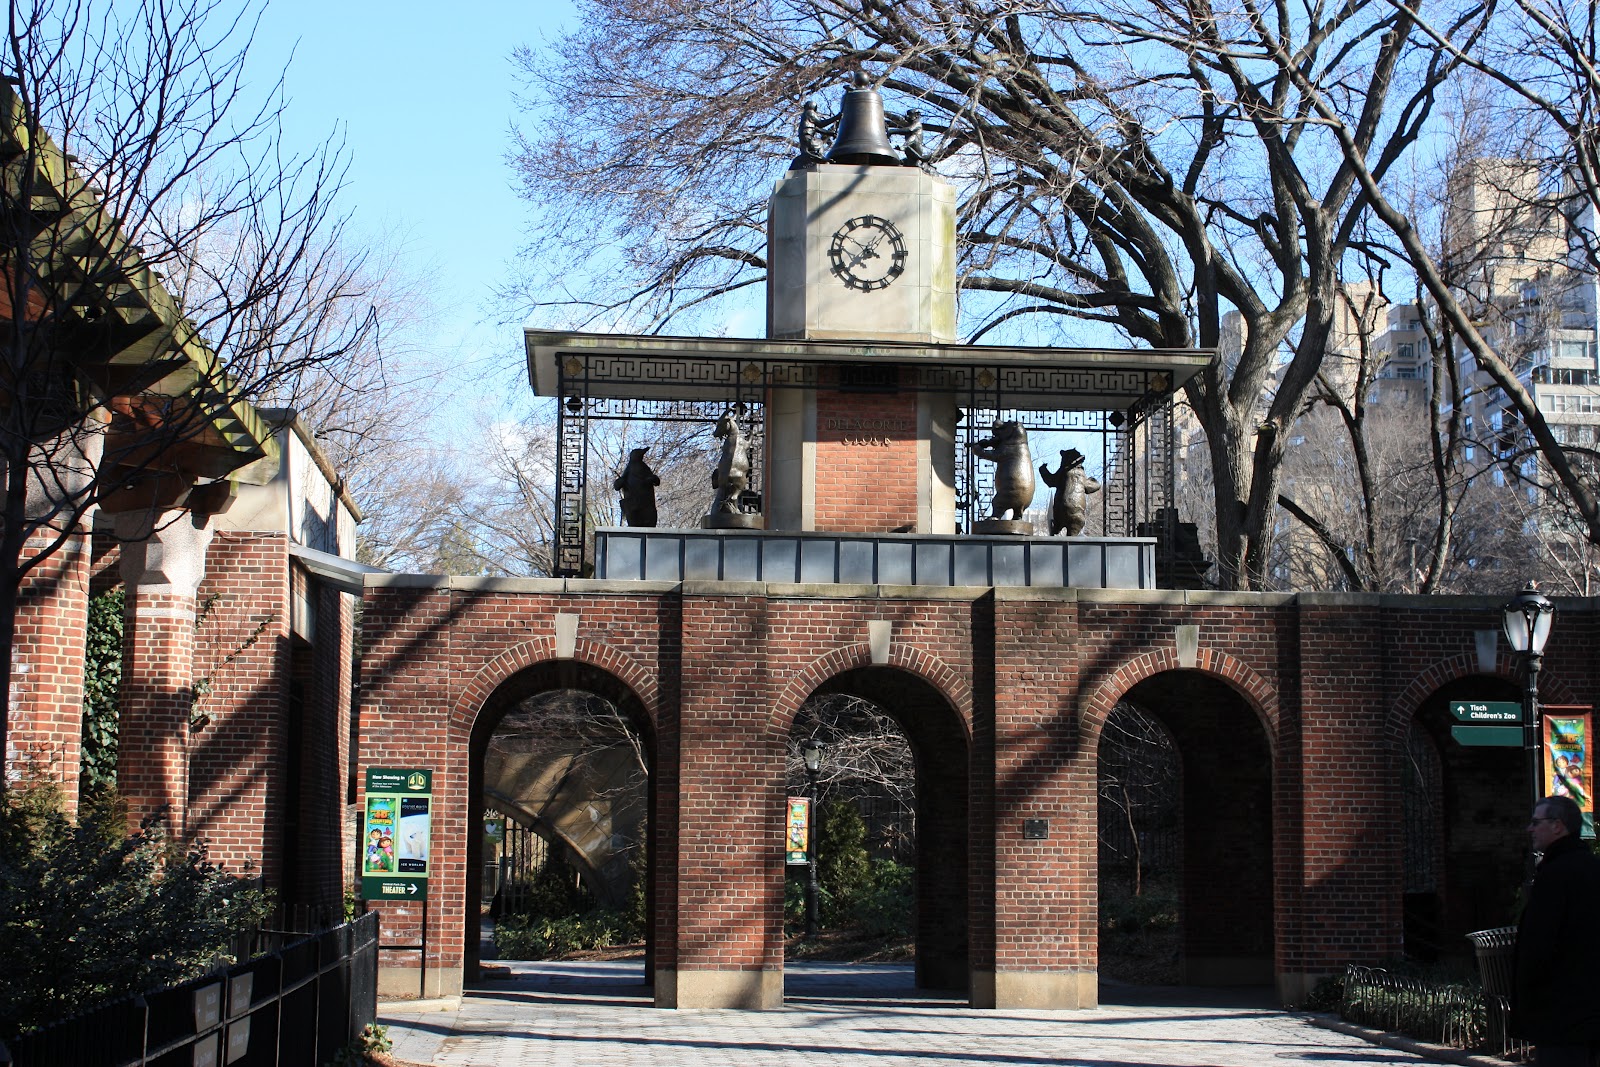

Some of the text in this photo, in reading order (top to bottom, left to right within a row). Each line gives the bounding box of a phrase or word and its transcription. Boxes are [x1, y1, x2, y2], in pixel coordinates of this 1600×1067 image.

[828, 418, 906, 431] DELACORTE
[844, 433, 892, 444] CLOCK
[382, 886, 405, 894] THEATER
